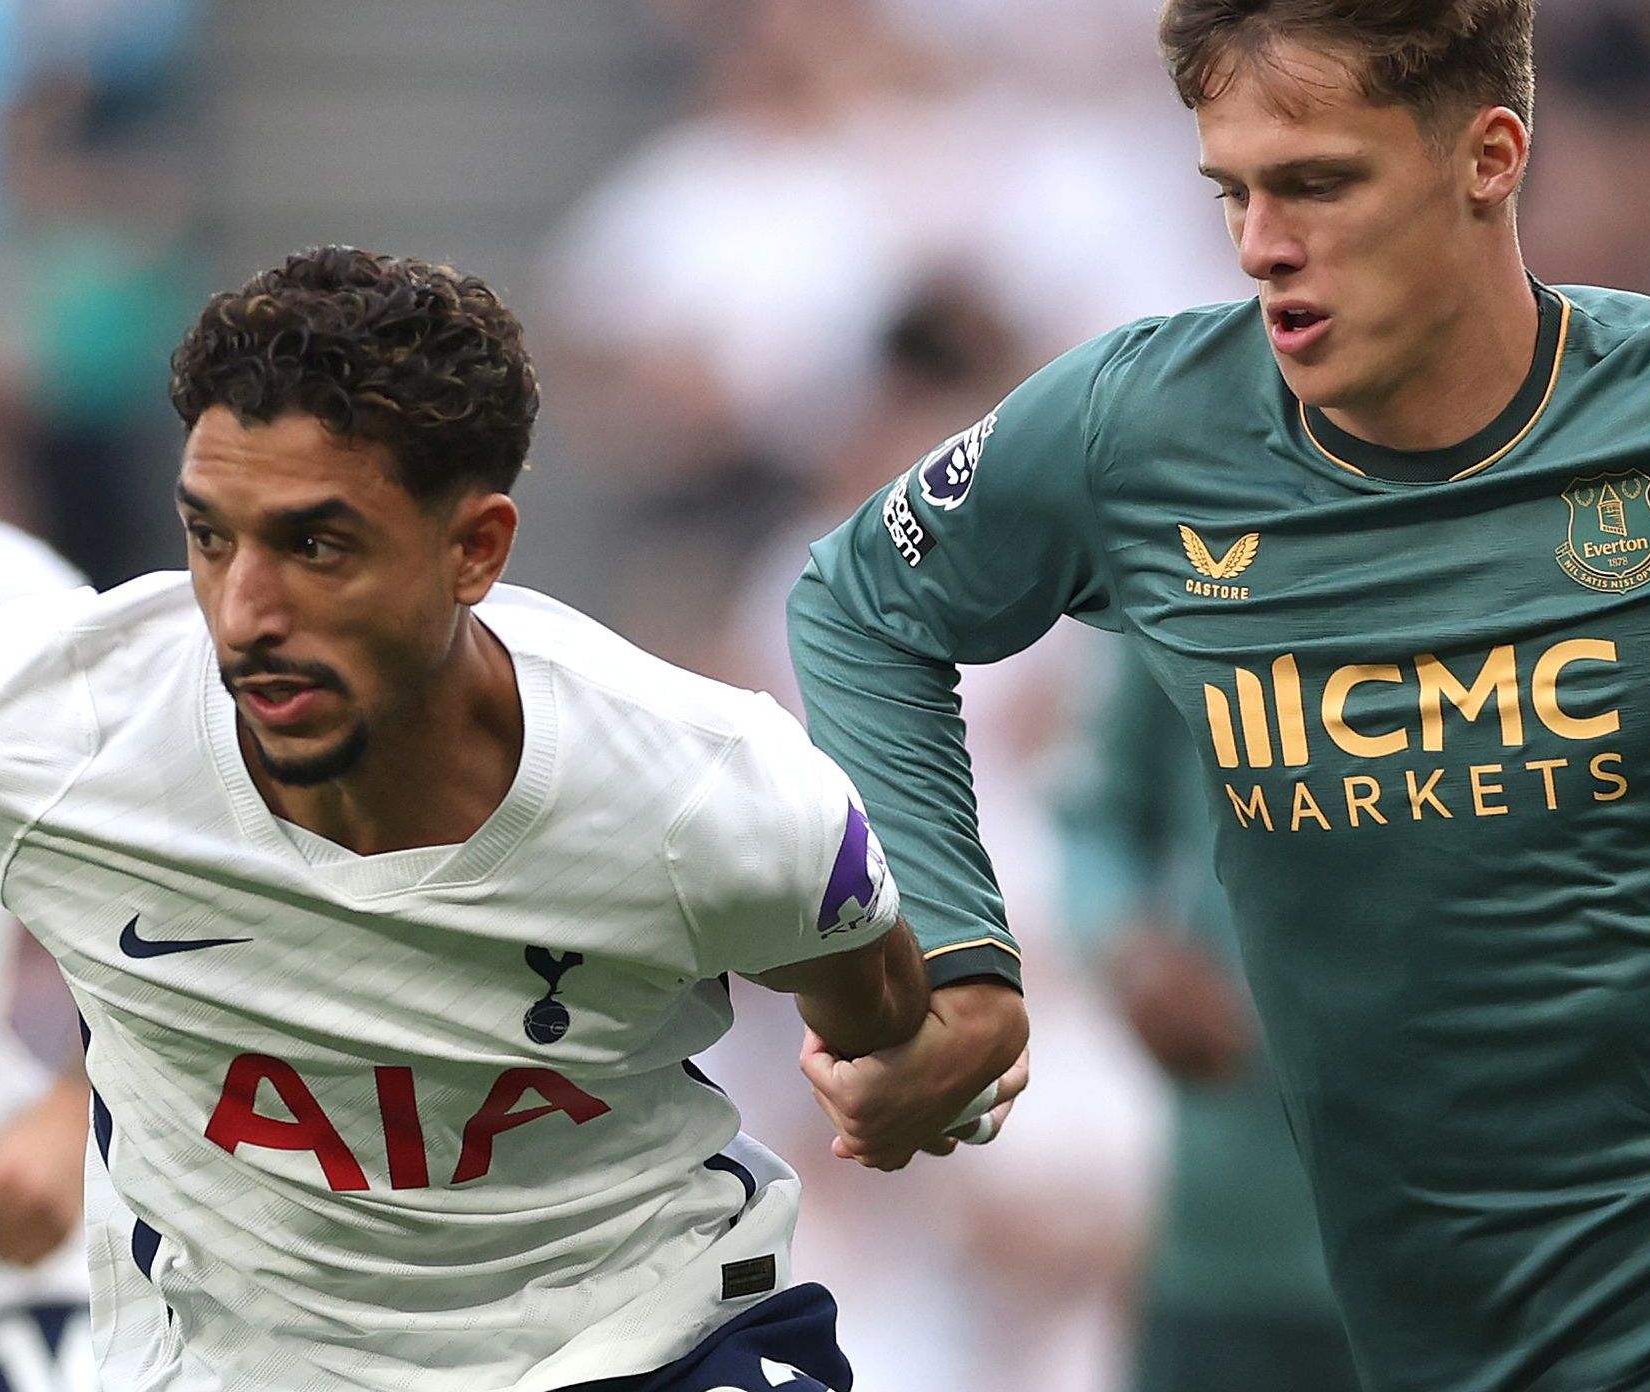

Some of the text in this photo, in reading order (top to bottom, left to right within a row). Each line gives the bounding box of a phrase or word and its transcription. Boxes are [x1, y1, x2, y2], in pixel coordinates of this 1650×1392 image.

[1583, 537, 1649, 559] Everton
[1607, 556, 1629, 568] 1878
[1185, 578, 1249, 600] CASTORE
[1564, 559, 1579, 577] NIL
[1580, 573, 1608, 588] SATIS
[1611, 579, 1635, 589] NISI
[1320, 638, 1622, 760] CMC
[1223, 752, 1629, 834] MARKETS
[203, 1052, 612, 1193] AIA
